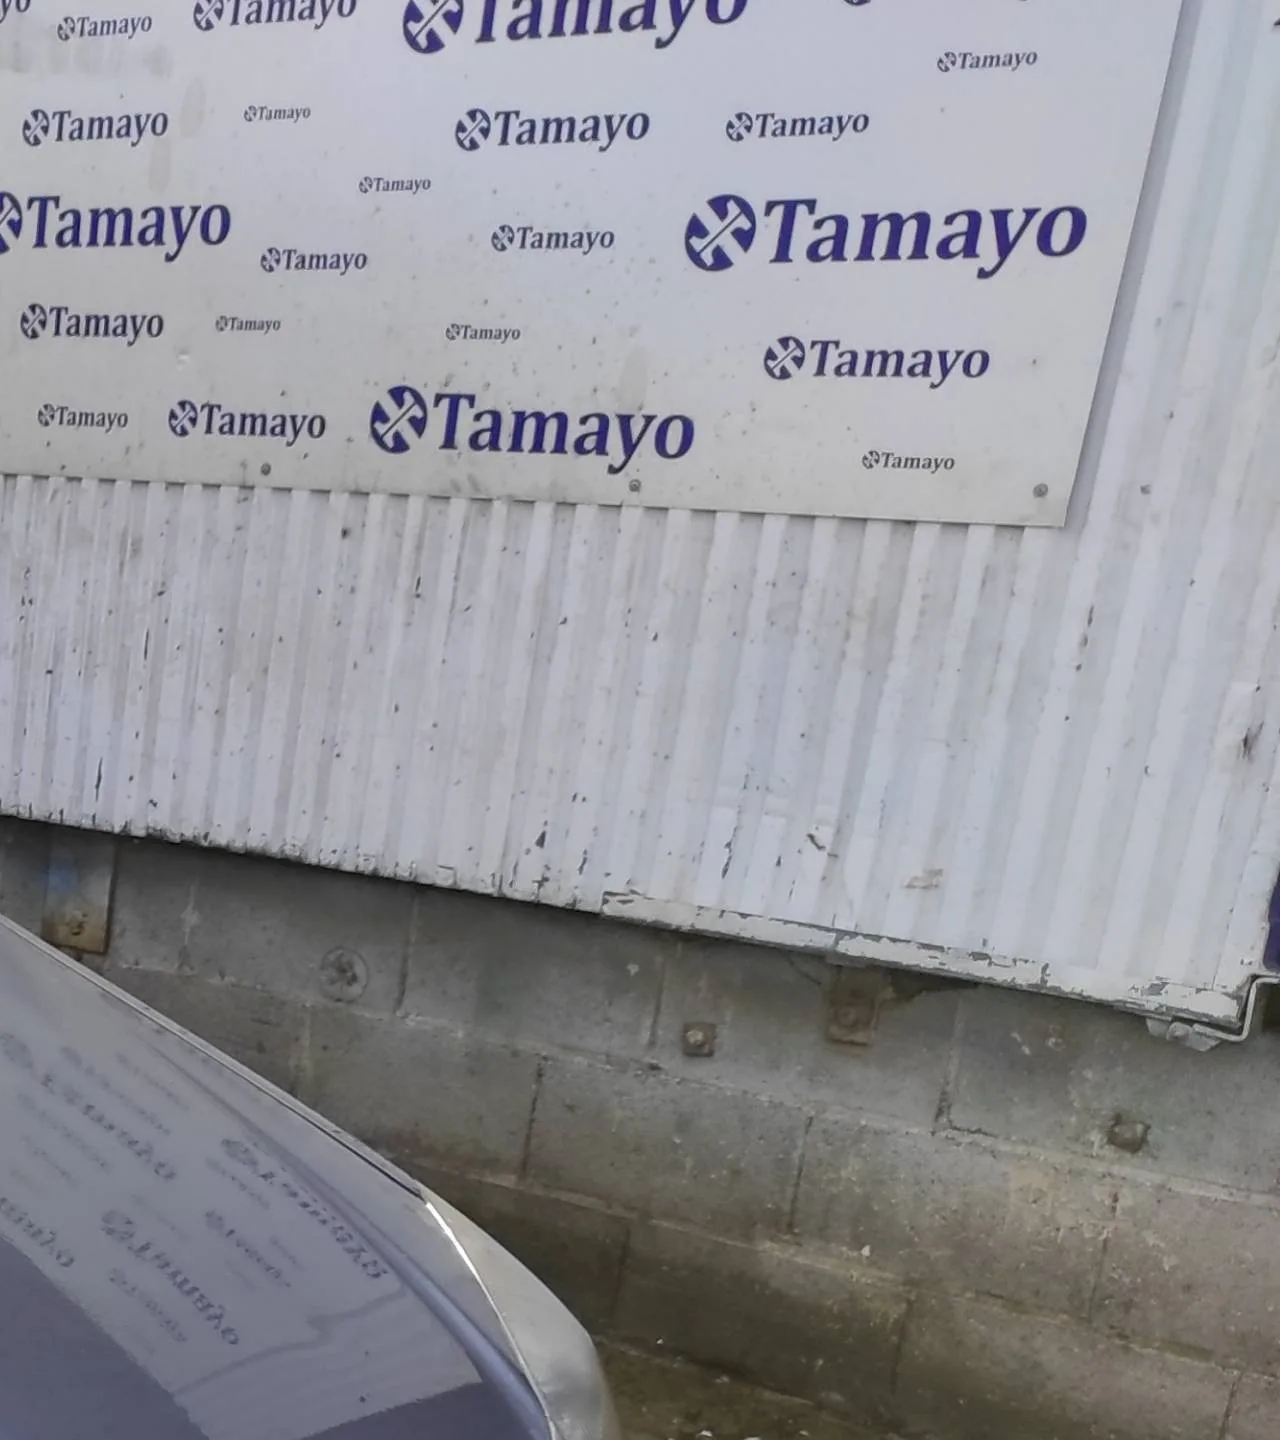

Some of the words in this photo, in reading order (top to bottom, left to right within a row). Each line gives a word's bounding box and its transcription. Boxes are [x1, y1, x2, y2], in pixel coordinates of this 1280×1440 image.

[75, 16, 152, 39] Tamayo
[230, 0, 357, 30] Tamayo
[957, 48, 1038, 72] Tamayo
[257, 106, 311, 122] Tamayo
[754, 112, 869, 141] Tamayo
[52, 110, 168, 147] Tamayo
[494, 110, 650, 152] Tamayo
[373, 177, 431, 194] Tamayo
[26, 195, 231, 261] Tamayo
[516, 227, 614, 255] Tamayo
[764, 198, 1087, 279] Tamayo
[282, 249, 368, 275] Tamayo
[48, 306, 164, 347] Tamayo
[229, 317, 281, 334] Tamayo
[461, 324, 520, 344] Tamayo
[809, 340, 990, 389] Tamayo
[55, 406, 128, 433] Tamayo
[200, 404, 325, 446] Tamayo
[433, 393, 694, 475] Tamayo
[881, 452, 955, 473] Tamayo
